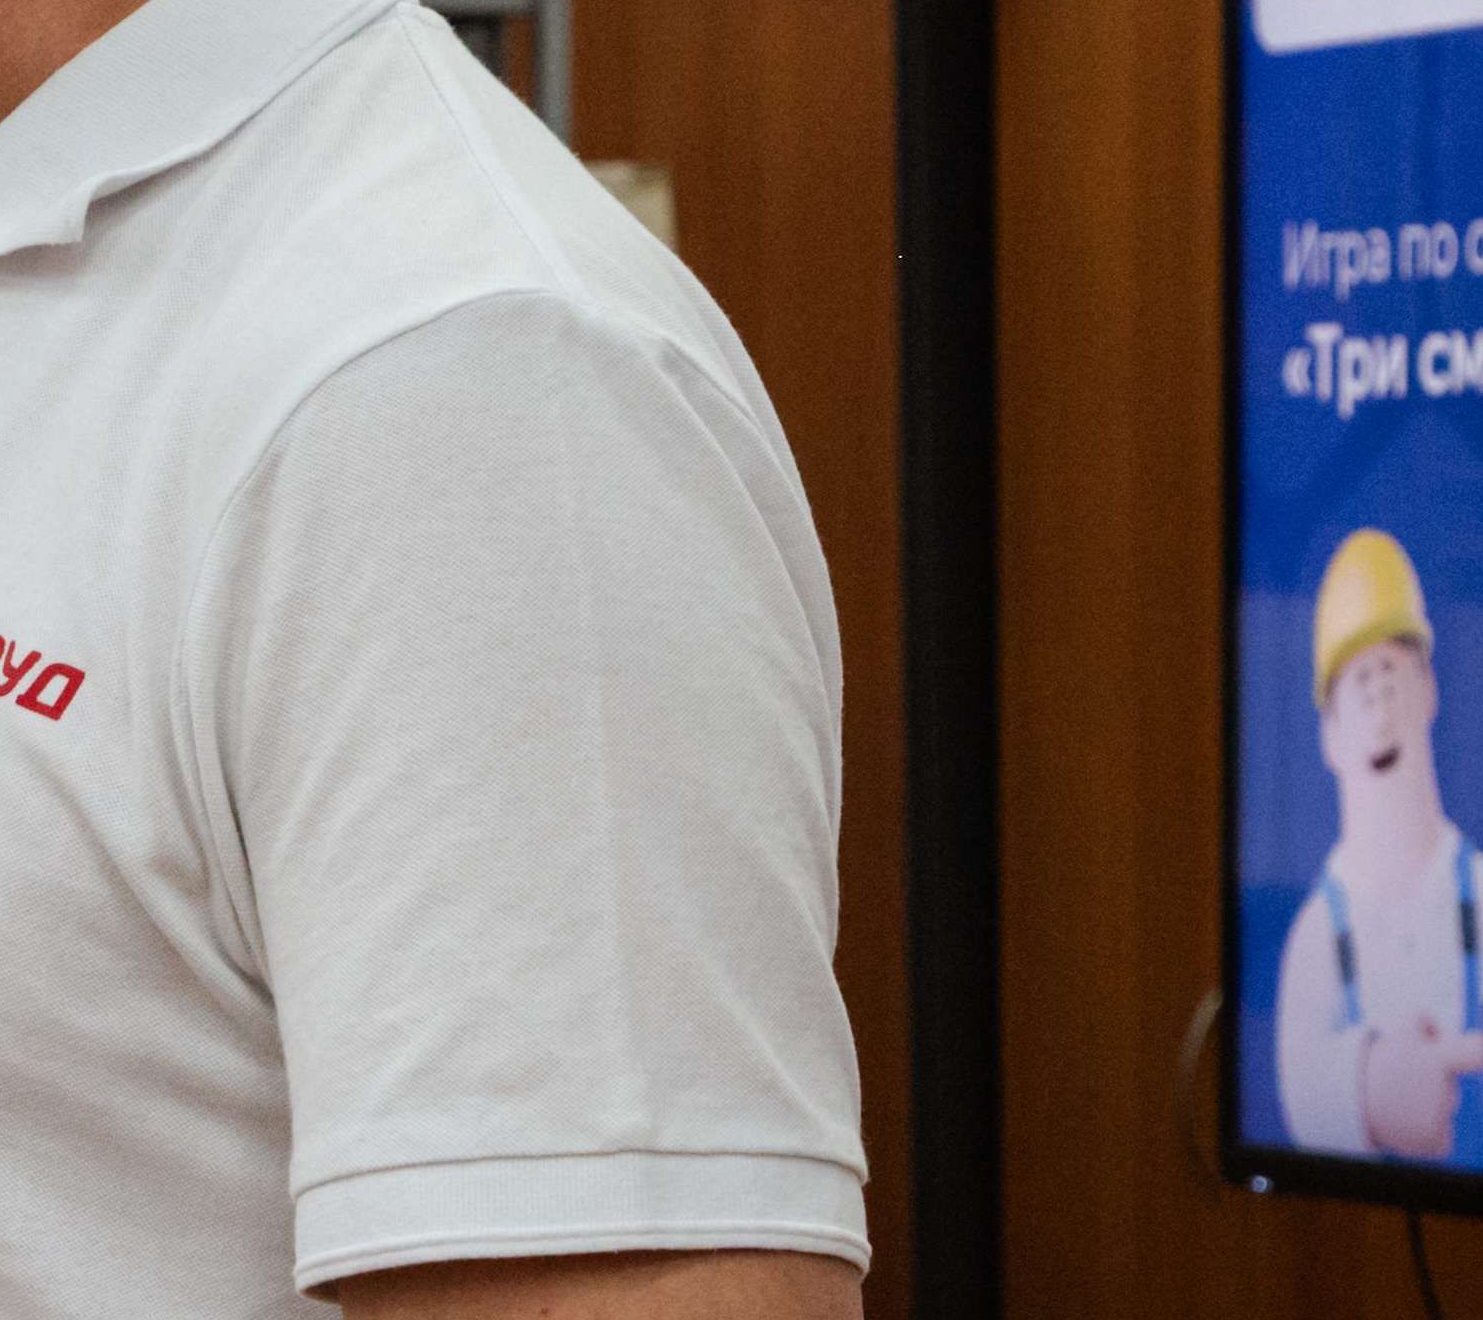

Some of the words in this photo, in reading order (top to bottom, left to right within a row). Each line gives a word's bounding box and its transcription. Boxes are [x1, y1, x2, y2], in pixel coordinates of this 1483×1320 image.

[1282, 221, 1390, 300] Игра
[1400, 221, 1459, 278] по
[1283, 322, 1407, 420] «Три
